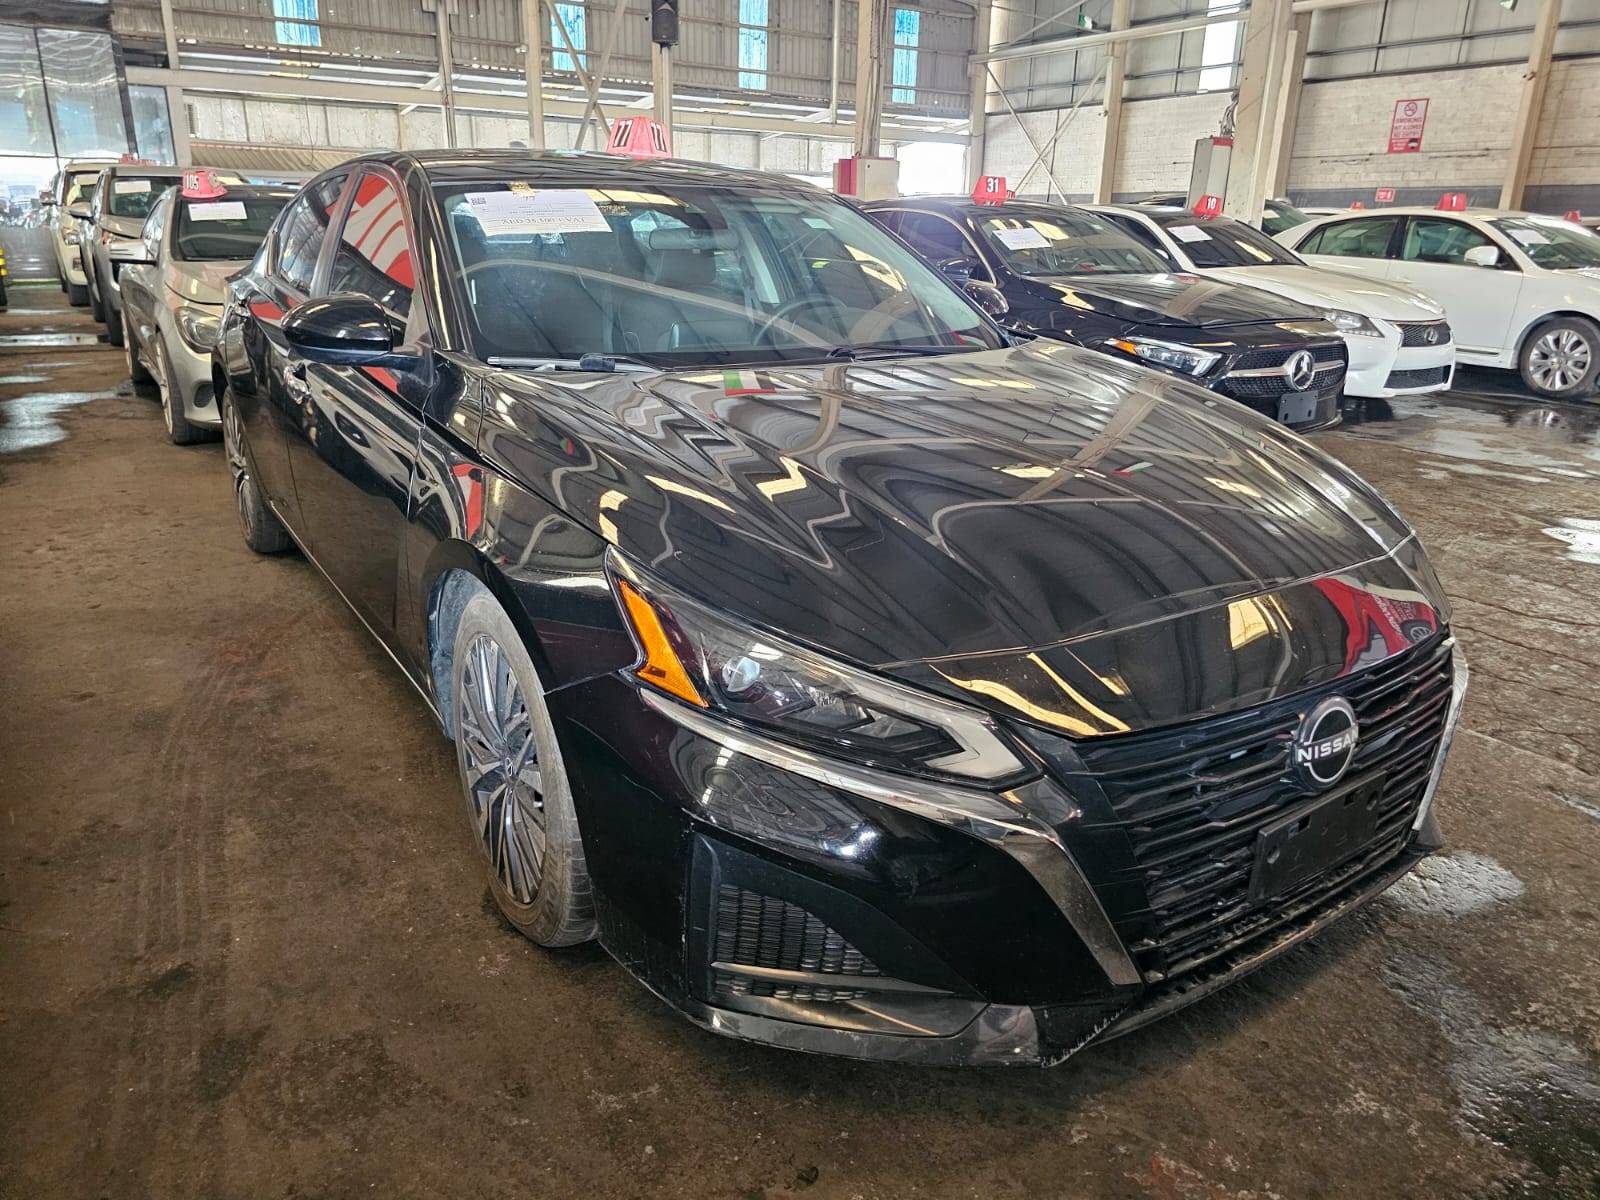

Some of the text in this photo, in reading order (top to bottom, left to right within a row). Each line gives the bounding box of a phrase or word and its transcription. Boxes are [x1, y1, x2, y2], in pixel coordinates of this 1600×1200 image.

[186, 174, 199, 190] 105
[986, 177, 999, 193] 31
[1207, 196, 1217, 210] 10
[1451, 195, 1457, 208] 1
